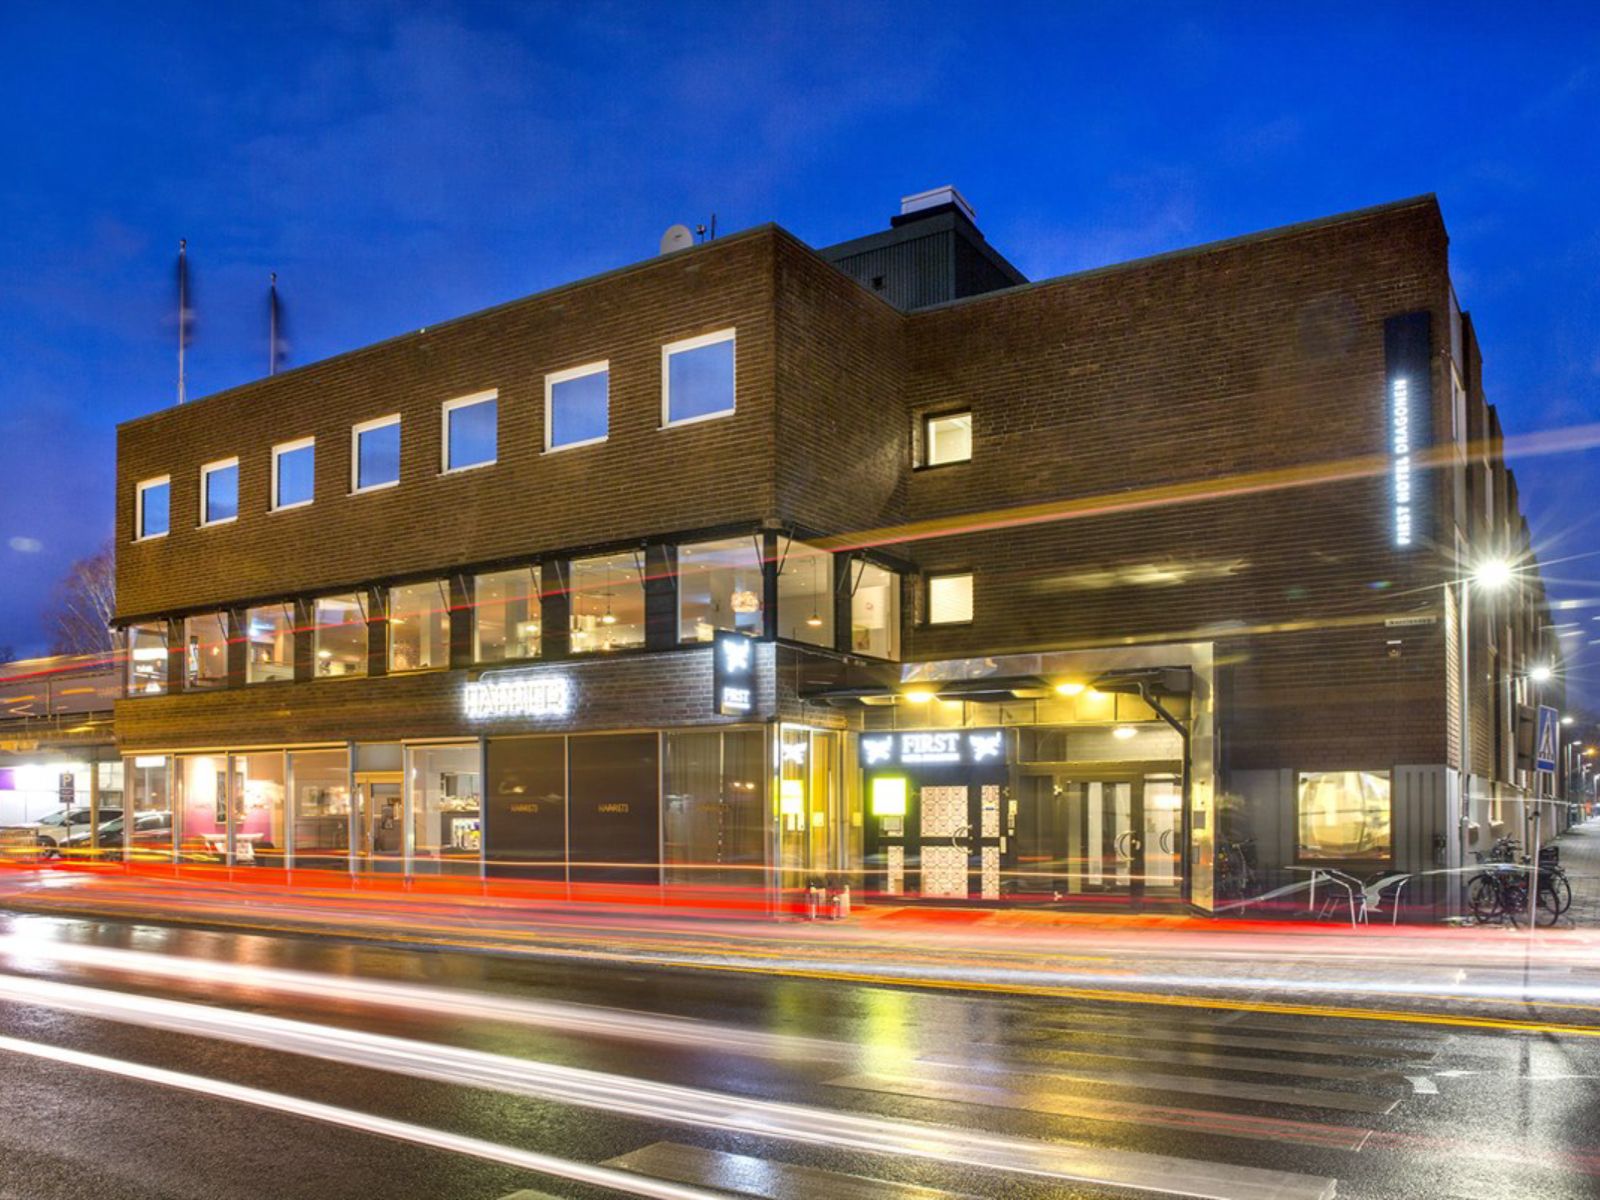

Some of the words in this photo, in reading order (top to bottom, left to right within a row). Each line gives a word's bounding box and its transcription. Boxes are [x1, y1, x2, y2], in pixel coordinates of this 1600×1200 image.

[1393, 379, 1408, 454] DRAGONEN
[1395, 457, 1410, 503] HOTEL
[1396, 506, 1411, 544] FIRST
[901, 733, 959, 753] FIRST
